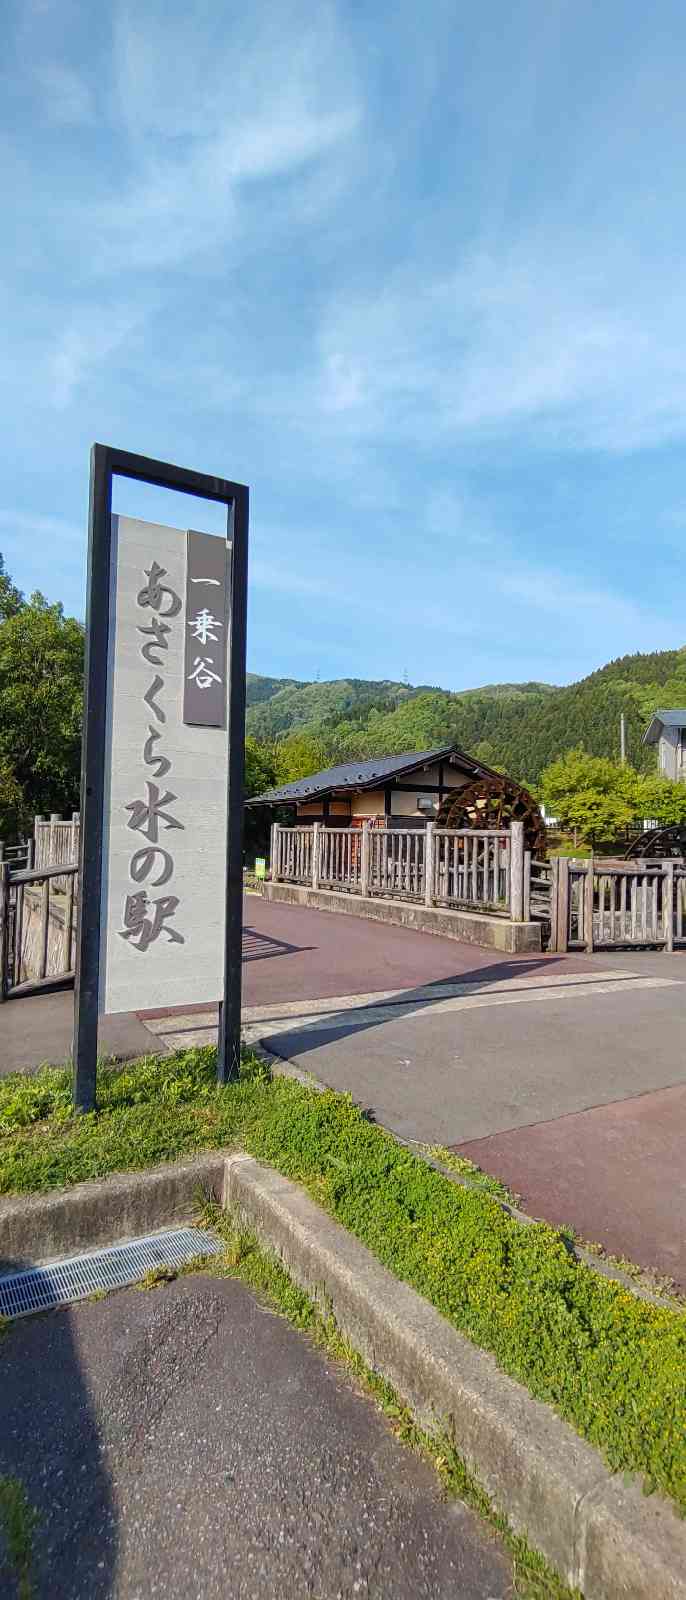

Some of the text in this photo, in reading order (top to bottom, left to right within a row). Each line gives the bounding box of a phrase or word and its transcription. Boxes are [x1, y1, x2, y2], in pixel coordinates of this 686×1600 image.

[117, 560, 186, 953] あさくら水の駅
[188, 577, 223, 690] 一乗谷
